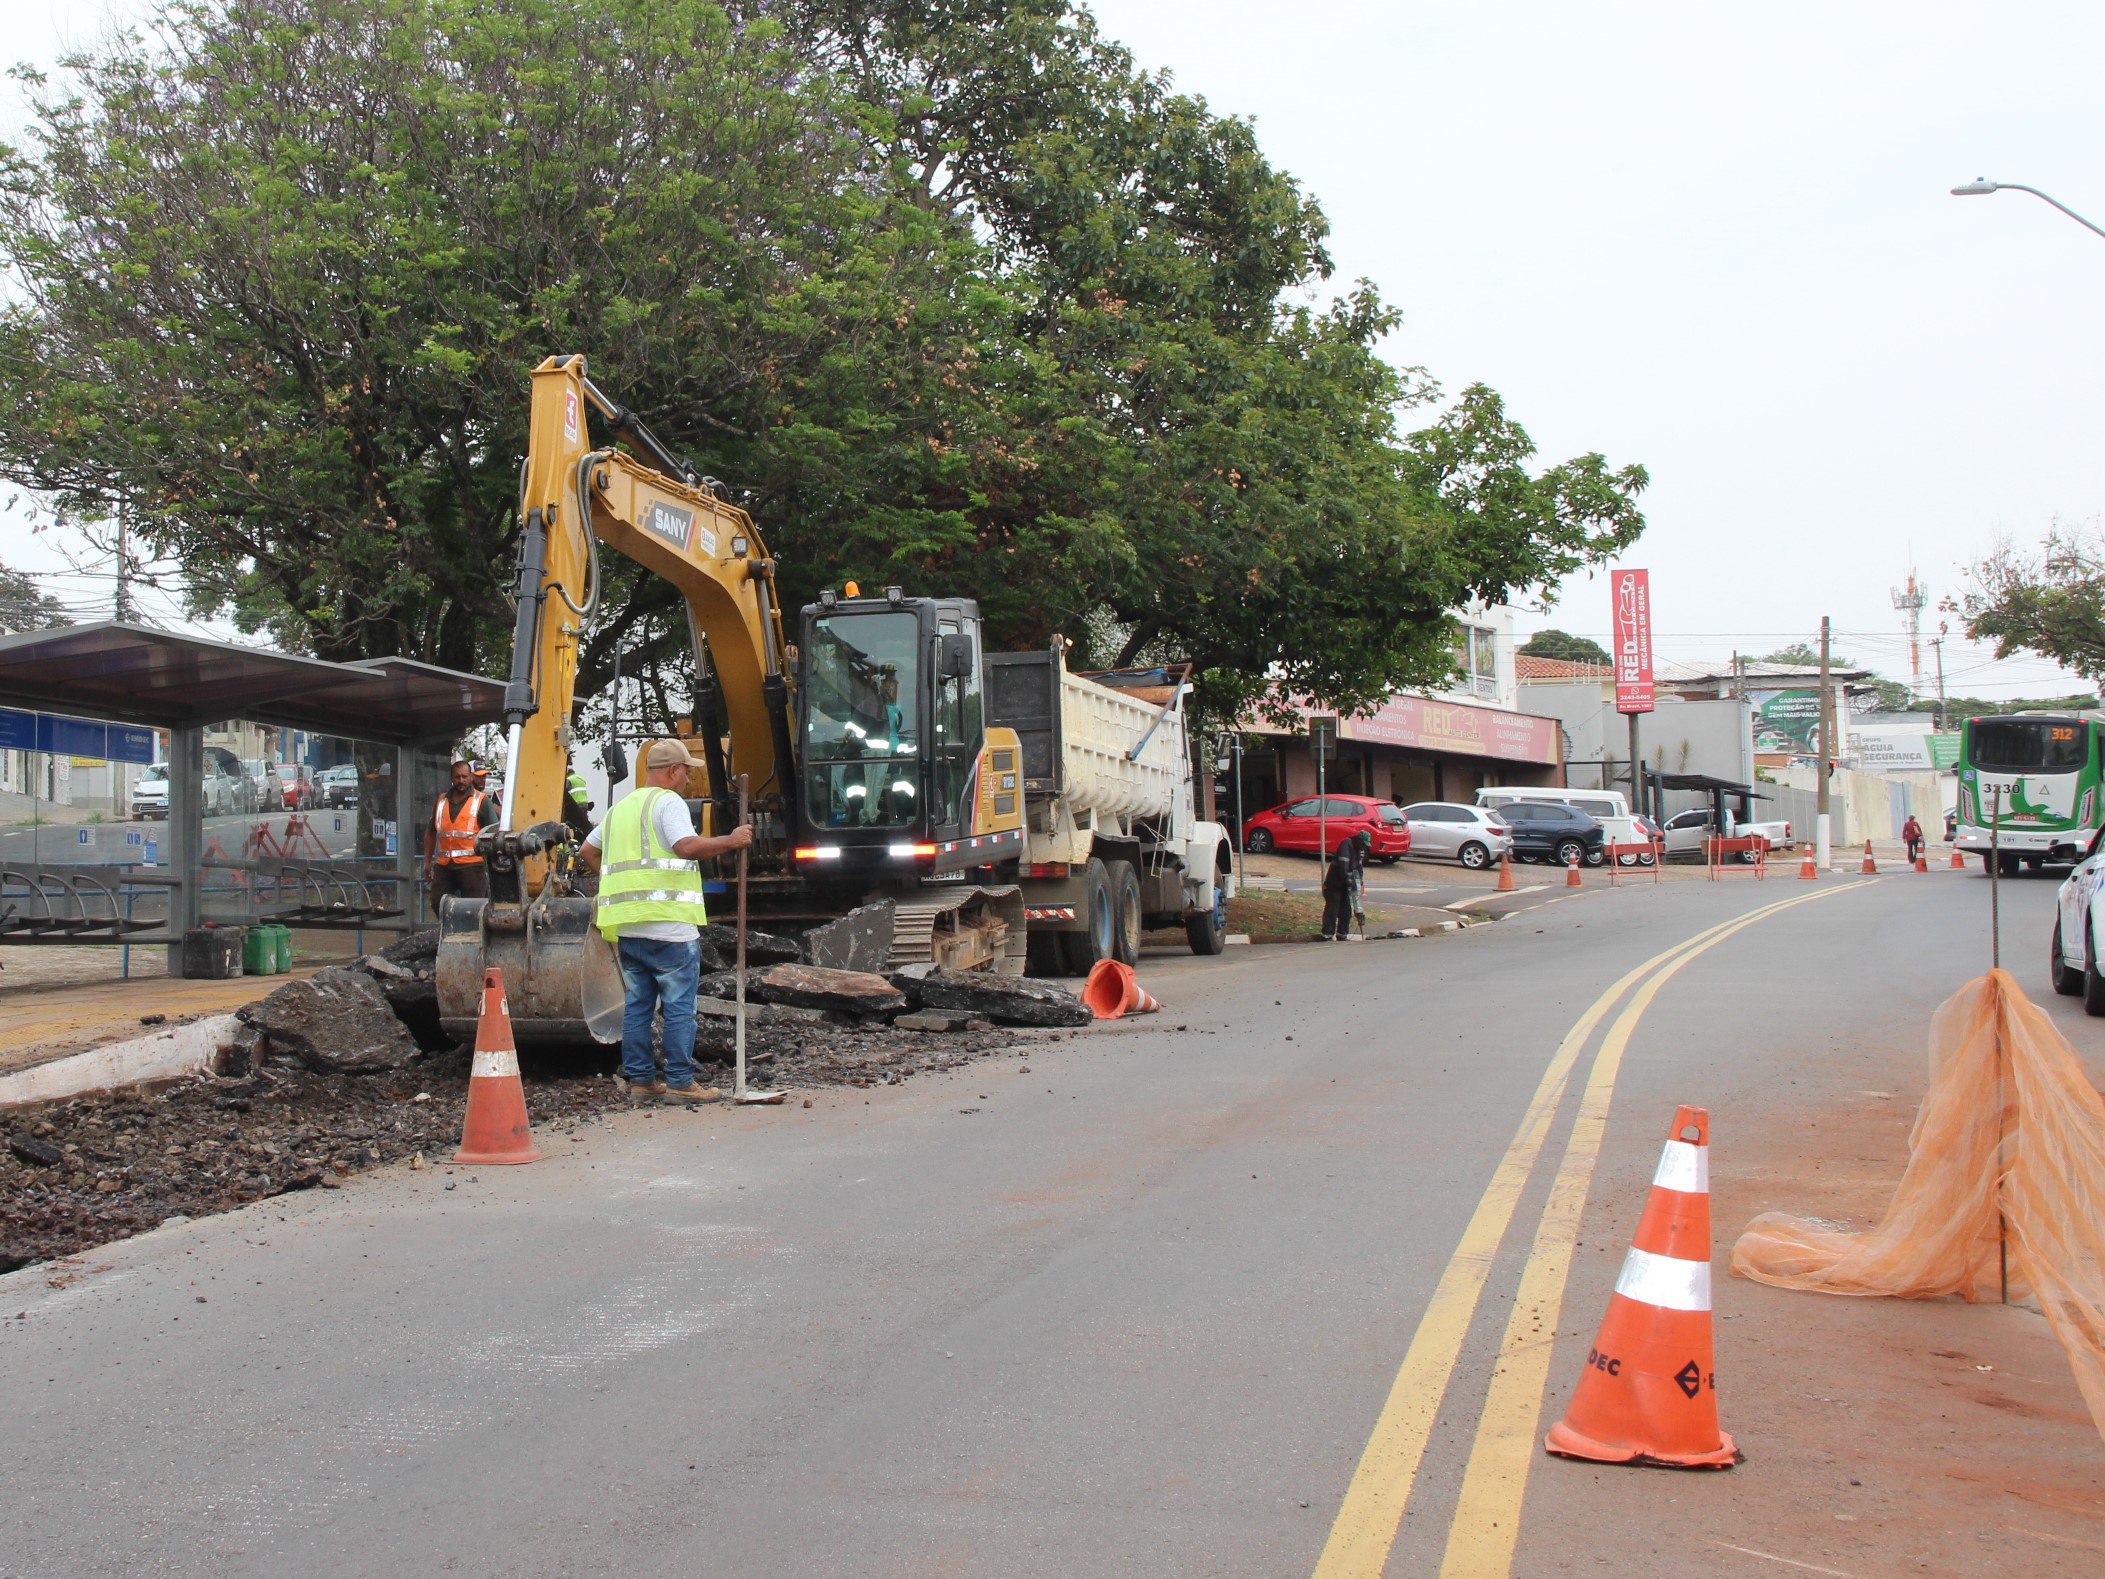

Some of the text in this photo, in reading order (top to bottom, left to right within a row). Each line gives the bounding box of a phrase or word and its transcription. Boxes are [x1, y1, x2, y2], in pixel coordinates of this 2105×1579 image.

[655, 508, 686, 540] SANY
[1637, 584, 1648, 670] MECÂNICA EM GERAL
[1623, 641, 1639, 682] RED
[1423, 706, 1450, 734] RED
[2051, 727, 2073, 740] 312
[1864, 753, 1922, 761] SEGURANÇA
[1588, 1348, 1621, 1376] DEC
